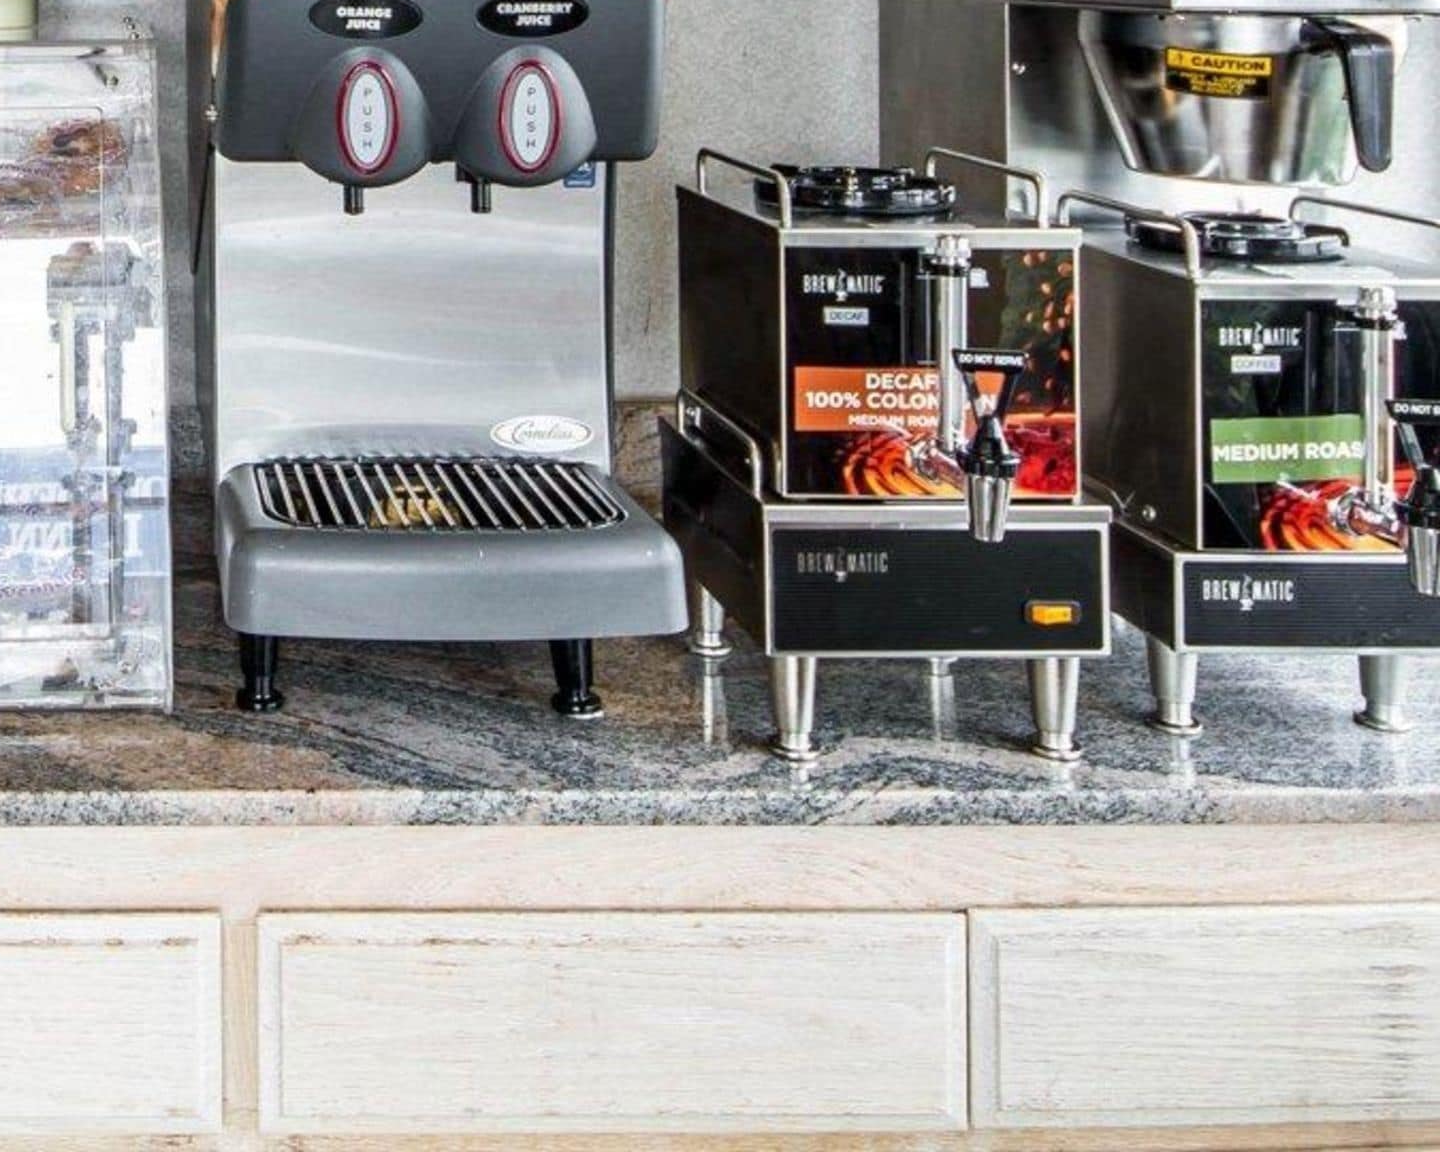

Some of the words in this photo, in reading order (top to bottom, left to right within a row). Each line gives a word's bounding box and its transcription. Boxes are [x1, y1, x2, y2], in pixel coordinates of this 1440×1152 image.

[335, 6, 392, 18] ORANGE
[496, 3, 574, 15] CRANBERRY
[345, 18, 382, 31] JUICE
[516, 14, 553, 27] JUICE
[1191, 55, 1266, 72] CAUTION
[959, 353, 973, 365] DO
[974, 354, 993, 365] NOT
[806, 392, 861, 409] 100%
[1394, 402, 1409, 414] DO
[848, 414, 905, 427] MEDIUM
[908, 414, 938, 427] ROA
[1213, 442, 1299, 462] MEDIUM
[1305, 441, 1365, 460] ROAS
